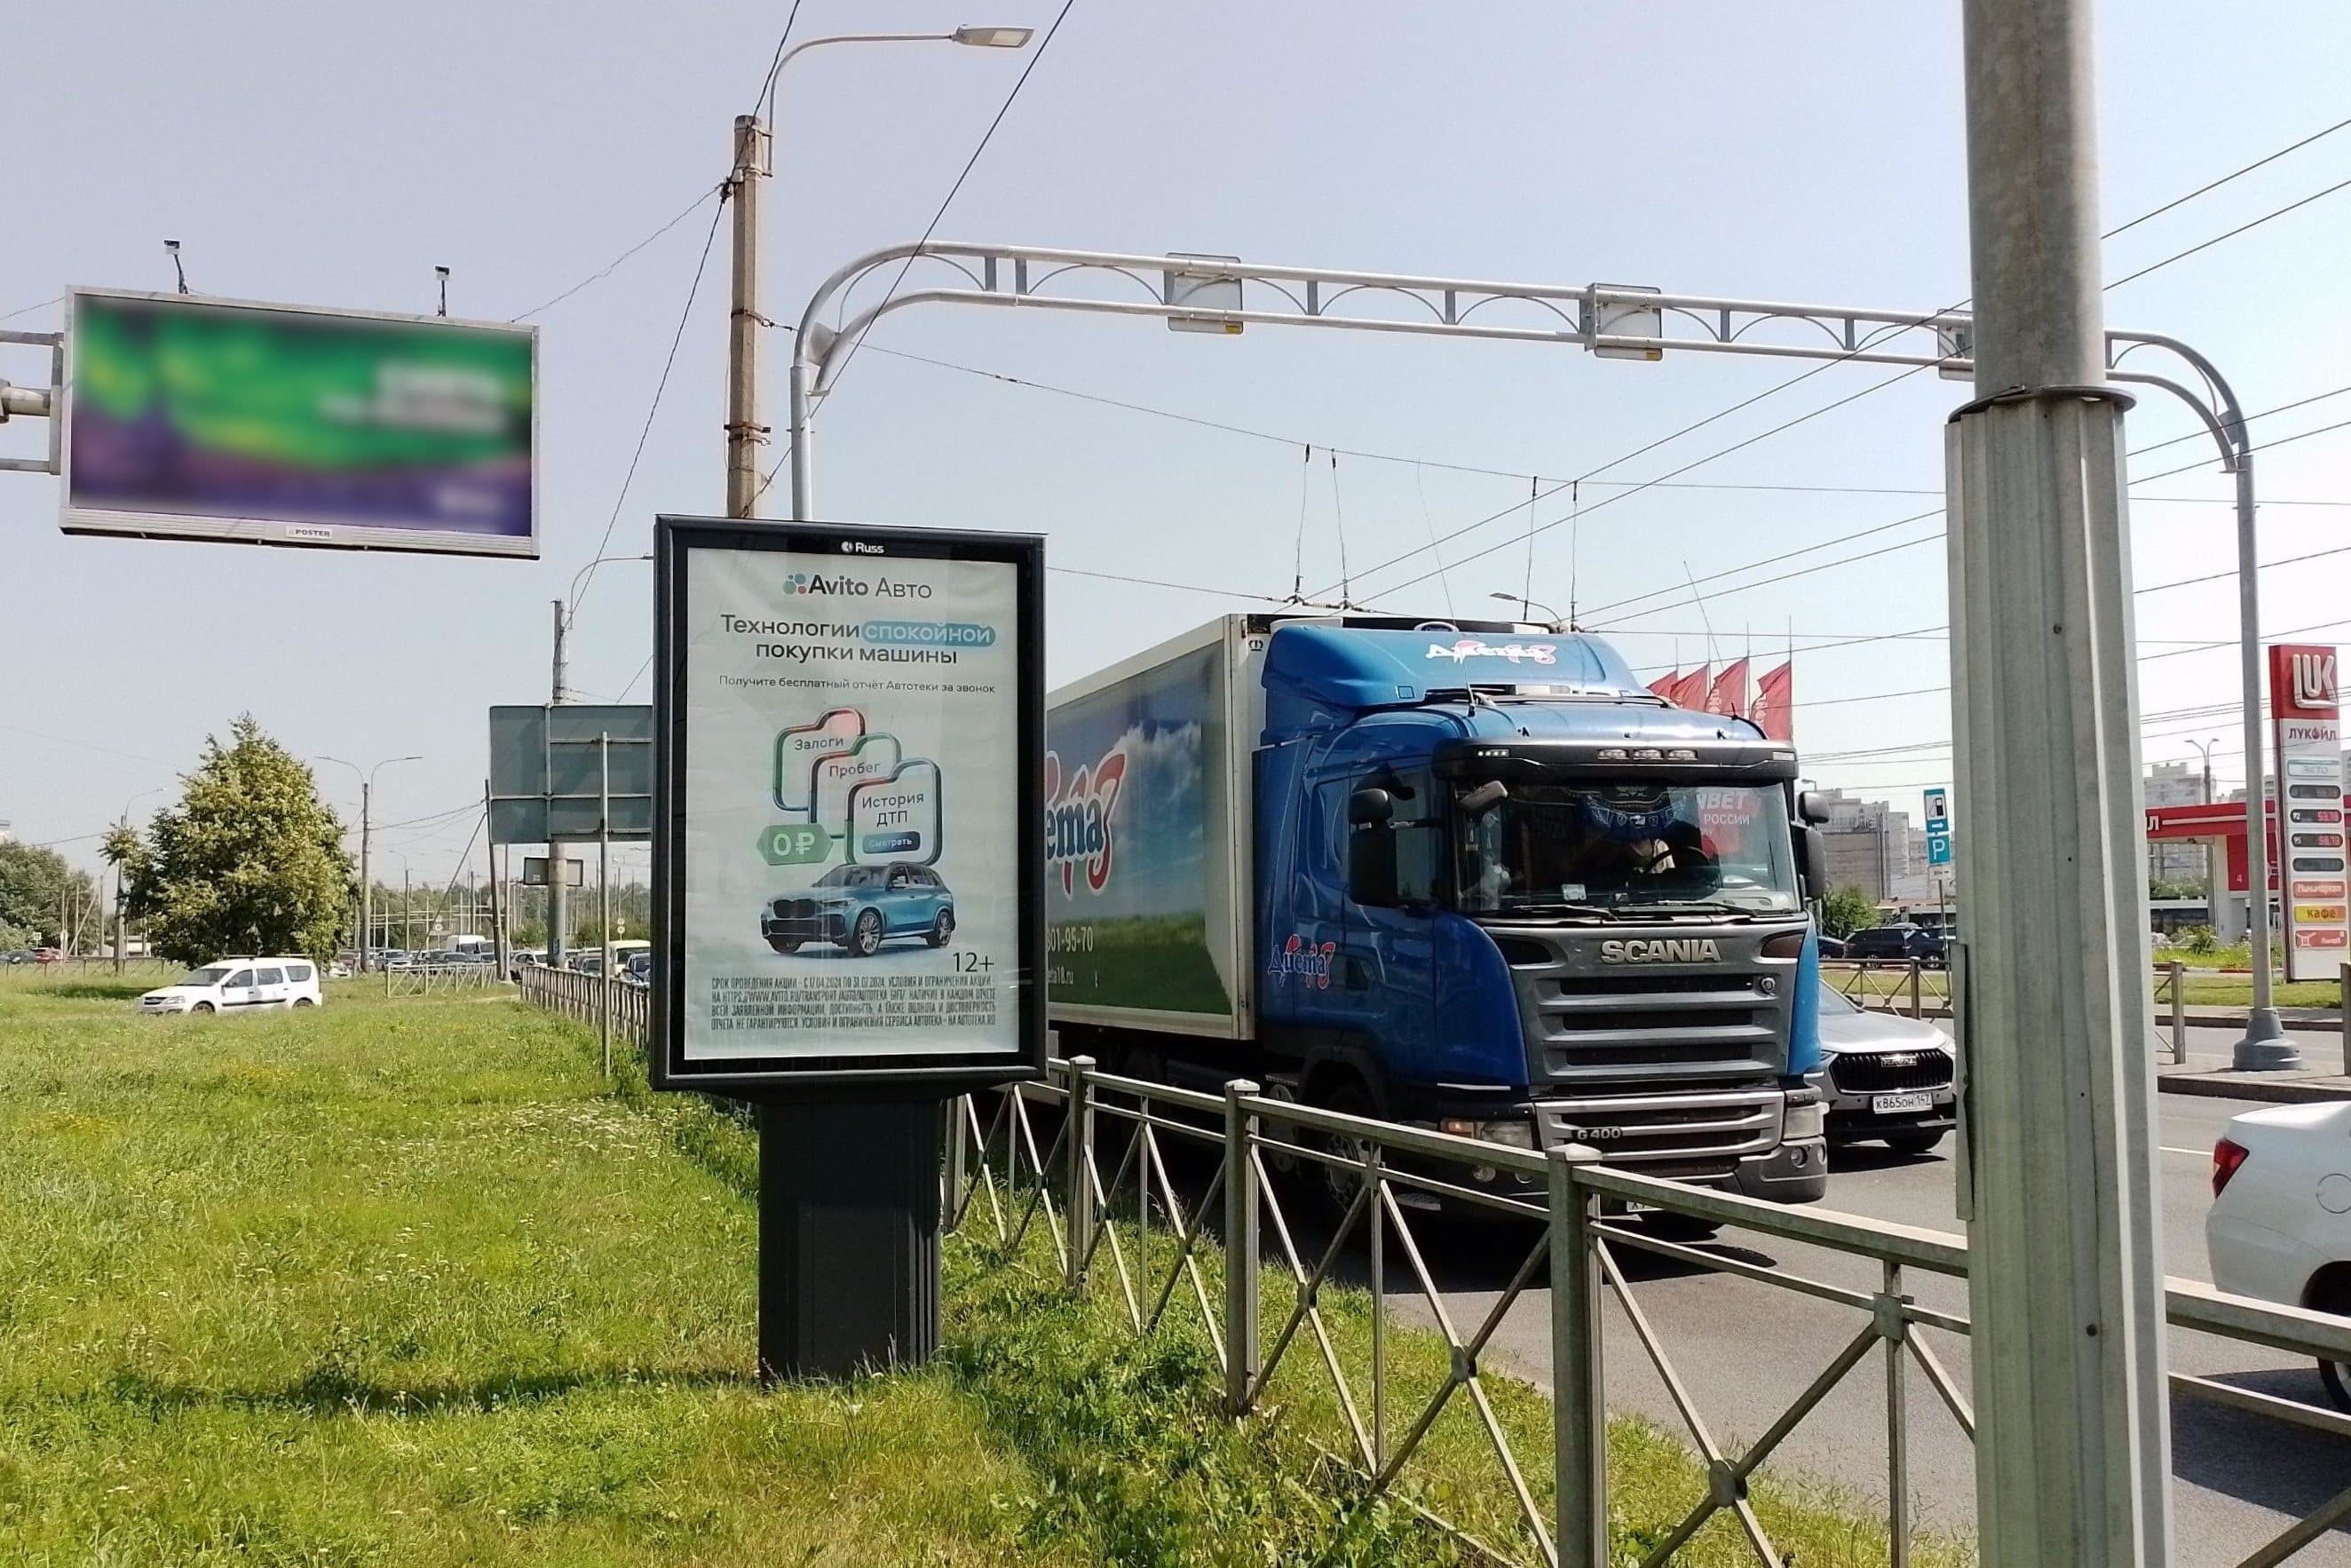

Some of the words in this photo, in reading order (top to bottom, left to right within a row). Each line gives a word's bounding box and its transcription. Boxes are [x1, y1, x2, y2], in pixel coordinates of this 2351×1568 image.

[855, 542, 885, 554] Russ
[808, 574, 869, 597] Avito
[875, 576, 932, 599] Авто
[720, 614, 859, 638] Технологии
[865, 623, 992, 644] спокойной
[756, 643, 853, 664] покупки
[859, 647, 957, 664] машины
[719, 675, 776, 688] Получите
[779, 677, 851, 690] бесплатный
[886, 680, 938, 692] Автотеки
[941, 684, 954, 693] за
[956, 684, 995, 693] звонок
[794, 737, 844, 751] Залоги
[828, 763, 881, 780] Пробег
[862, 793, 924, 810] История
[876, 810, 907, 828] ДТП
[1705, 813, 1751, 825] РОССИИ
[2292, 812, 2301, 821] 92
[2293, 835, 2303, 845] 95
[1601, 939, 1722, 964] SCANIA
[952, 951, 995, 974] 12+
[711, 977, 730, 990] СРОК
[731, 977, 773, 990] ПРОВЕДЕНИЯ
[774, 977, 797, 989] АКЦИИ
[889, 976, 917, 987] УСЛОВИЯ
[924, 976, 969, 987] ОГРАНИЧЕНИЯ
[970, 975, 992, 986] АКЦИИ
[711, 1004, 729, 1018] ВСЕЙ
[731, 1002, 774, 1017] ЗАЯВЛЕННОЙ
[711, 1018, 734, 1031] ОТЧЕТА
[839, 1016, 884, 1028] ОГРАНИЧЕНИЯ
[1577, 1128, 1588, 1140] G
[1590, 1128, 1622, 1139] 400
